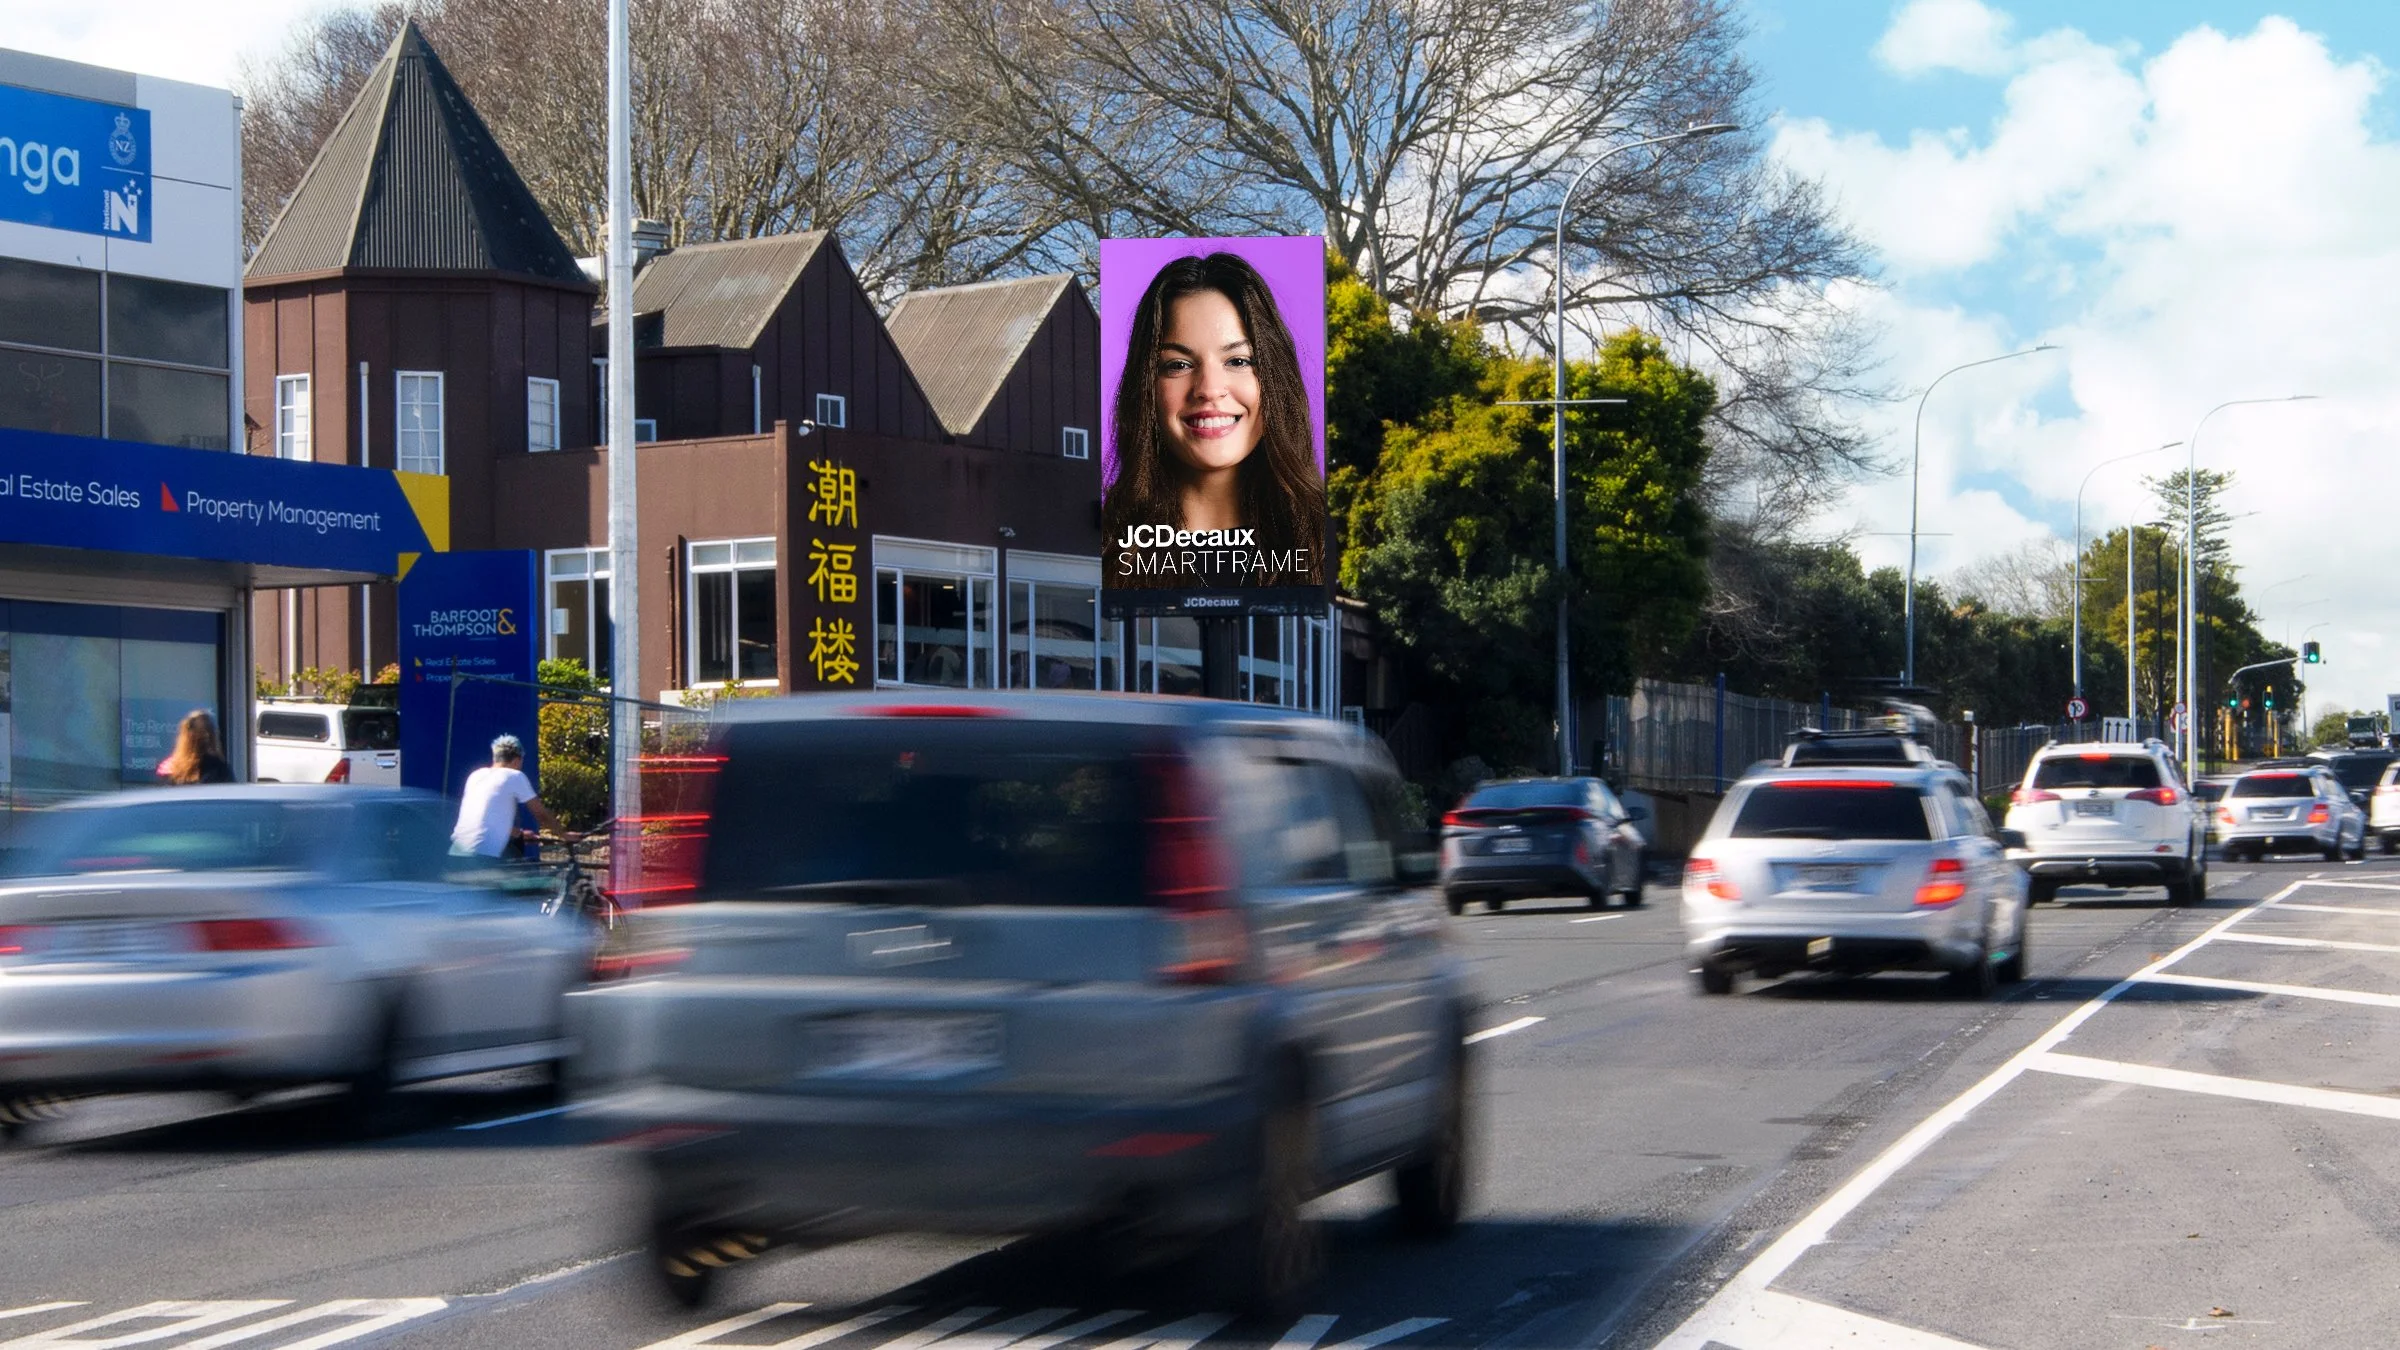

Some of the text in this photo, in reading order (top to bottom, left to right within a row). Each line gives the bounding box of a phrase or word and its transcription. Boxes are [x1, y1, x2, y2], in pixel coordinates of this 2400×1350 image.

[115, 139, 131, 153] NZ
[20, 474, 83, 503] Estate
[87, 481, 141, 508] Sales
[187, 491, 264, 527] Property
[268, 499, 381, 534] Management
[1118, 524, 1256, 548] JCDecaux
[806, 459, 860, 684] 潮福楼
[1118, 548, 1309, 576] SMARTFRAME
[1184, 596, 1240, 608] JCDecaux
[412, 623, 497, 637] THOMPSON
[430, 608, 517, 635] BARFOOT &
[425, 658, 443, 667] Real
[473, 657, 497, 666] Sales
